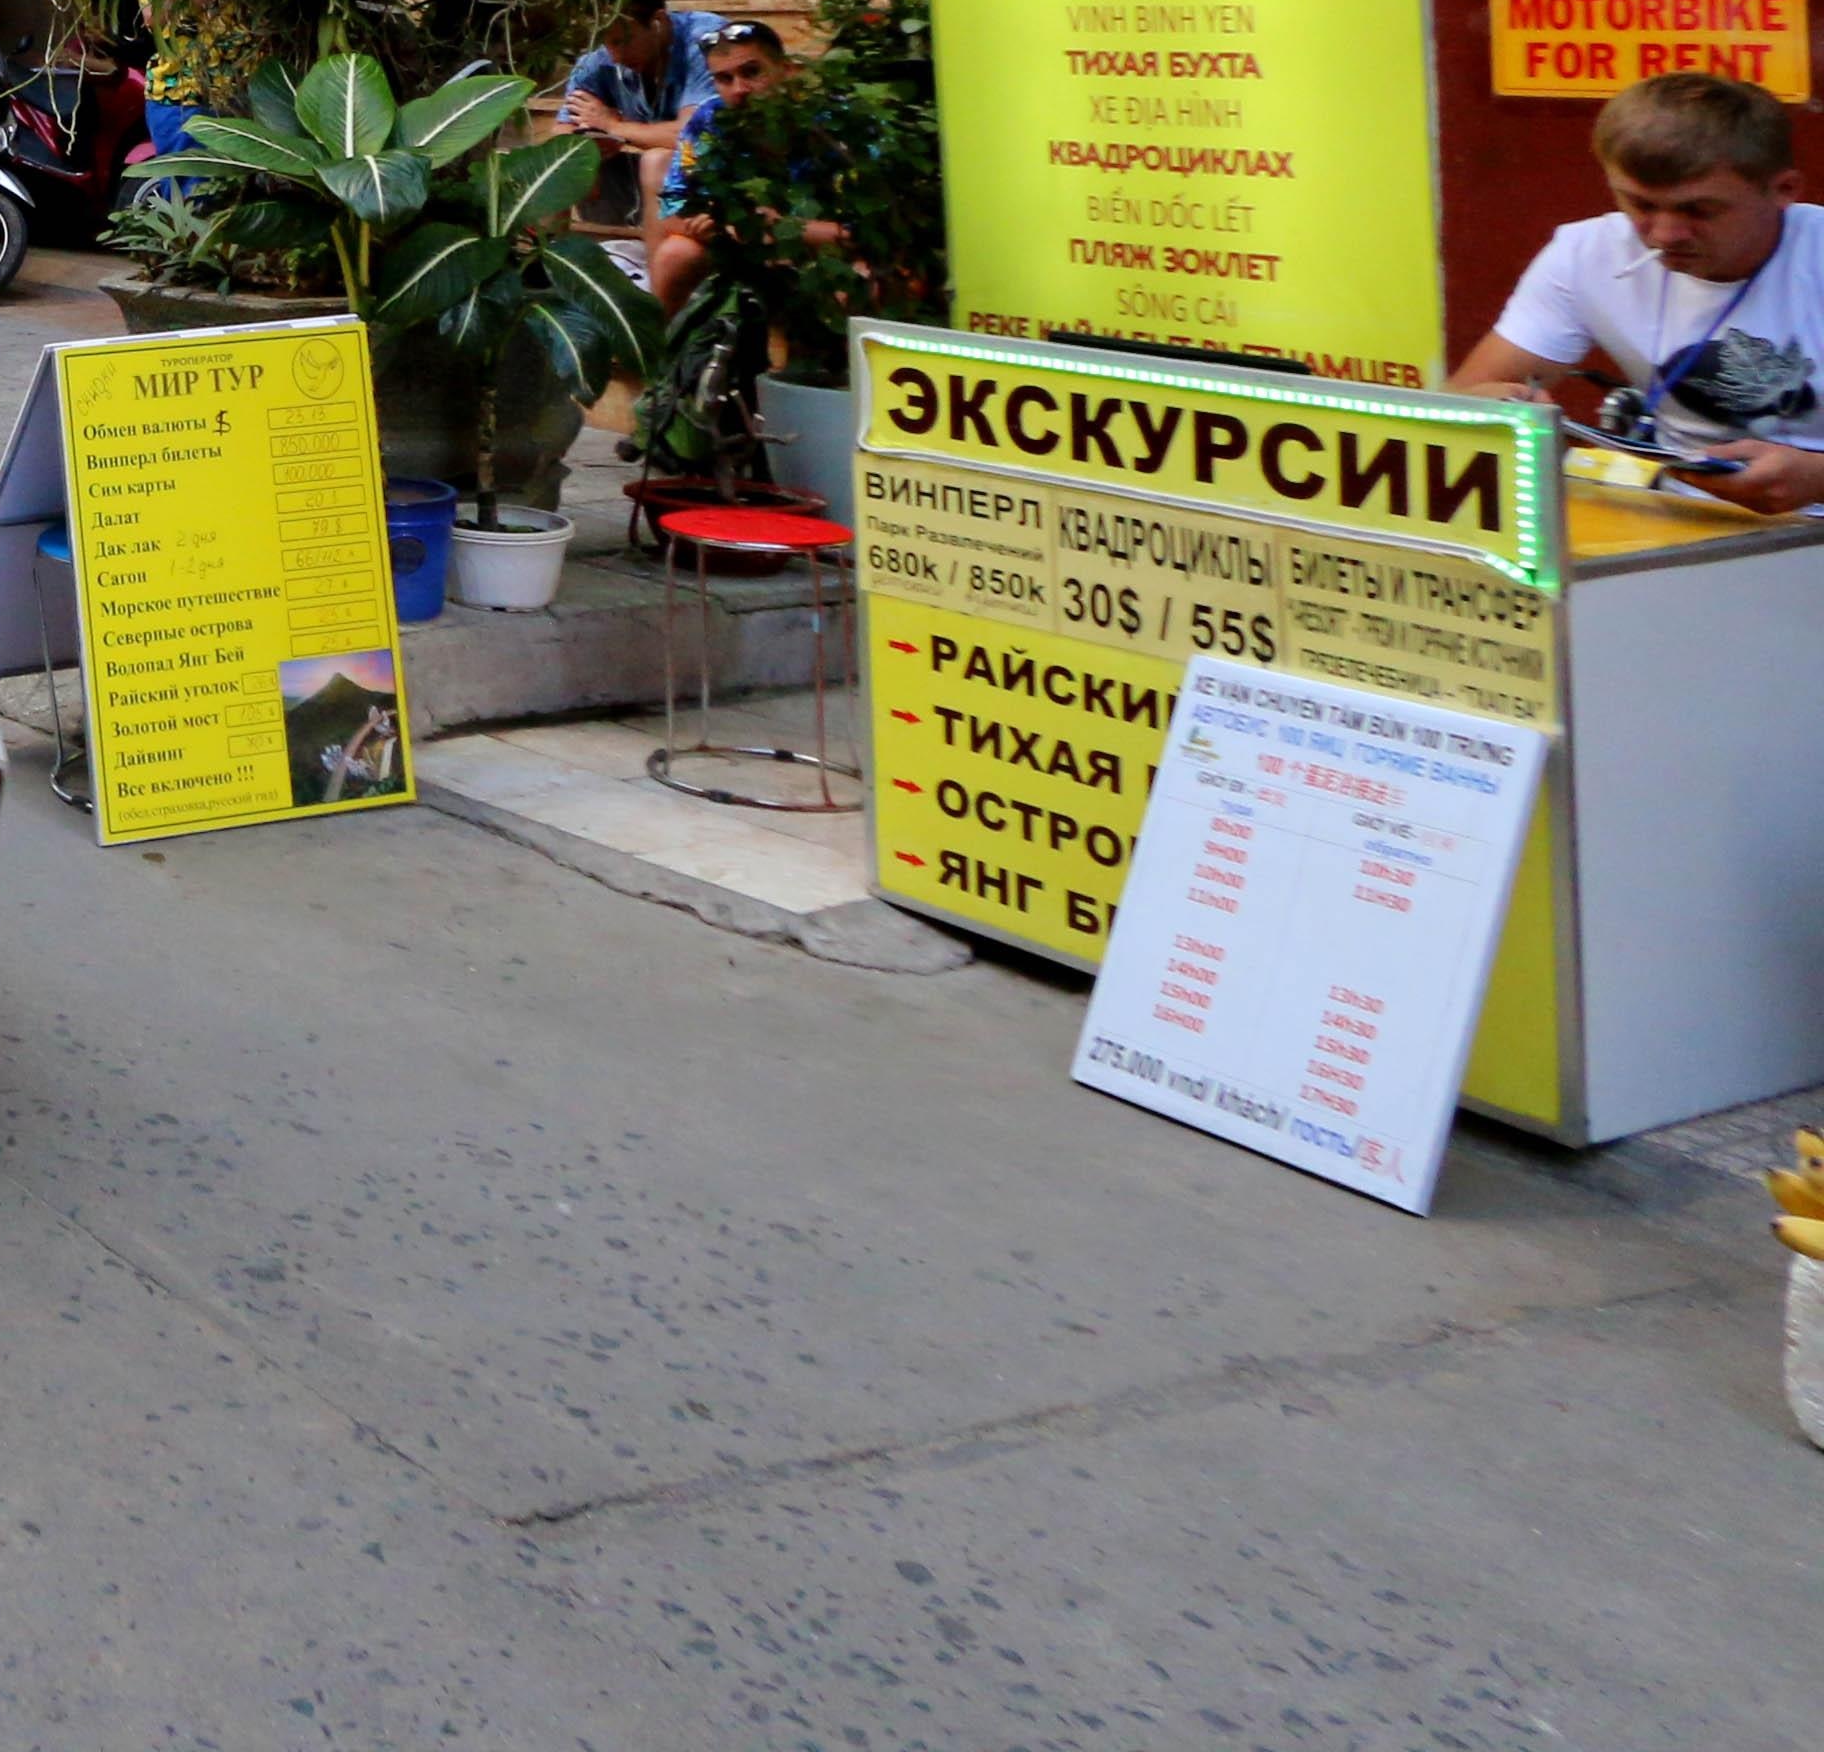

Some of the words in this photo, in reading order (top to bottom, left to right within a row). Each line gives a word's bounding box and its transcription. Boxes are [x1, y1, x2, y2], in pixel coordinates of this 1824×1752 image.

[1065, 50, 1158, 76] ТИХАЯ
[1169, 52, 1263, 79] БУХТА
[1524, 41, 1618, 80] FOR
[1637, 41, 1773, 85] RENT
[1049, 140, 1294, 179] КВАДРОЦИКЛАХ
[1069, 239, 1155, 270] ПЛЯЖ
[1163, 246, 1281, 281] ЗОКЛЕТ
[968, 311, 1030, 338] РЕКЕ
[161, 353, 233, 367] ТУРОПЕРАТОР
[133, 370, 198, 401] МИР
[206, 364, 264, 393] ТУР
[83, 422, 136, 441] Обмен
[142, 415, 207, 436] валюты
[86, 451, 157, 471] Винперл
[161, 444, 222, 464] билеты
[887, 365, 1502, 533] ЭКСКУРСИИ
[89, 482, 123, 499] Сим
[127, 477, 176, 498] карты
[91, 511, 141, 531] Далат
[865, 471, 1043, 529] ВИНПЕРЛ
[1059, 504, 1272, 590] КВАДРОЦИКЛЫ
[866, 515, 911, 540] Парк
[94, 541, 128, 561] Дак
[133, 538, 161, 554] лак
[97, 570, 147, 588] Сагон
[868, 543, 939, 582] 680k
[970, 561, 1047, 606] 850k
[100, 596, 172, 619] Морское
[176, 585, 281, 611] путешествие
[103, 625, 186, 648] Северные
[190, 616, 253, 638] острова
[1062, 575, 1143, 637] 30$
[1190, 604, 1277, 664] 55$
[106, 656, 175, 679] Водопад
[179, 652, 209, 668] Янг
[214, 646, 245, 665] Бей
[109, 685, 179, 708] Райский
[183, 678, 240, 703] уголок
[112, 717, 177, 739] Золотой
[183, 713, 220, 727] мост
[115, 748, 184, 771] Дайвинг
[932, 705, 1122, 795] ТИХАЯ
[117, 782, 148, 798] Все
[151, 774, 232, 796] включено
[937, 779, 1138, 868] ОСТРО
[938, 849, 1045, 914] ЯНГ
